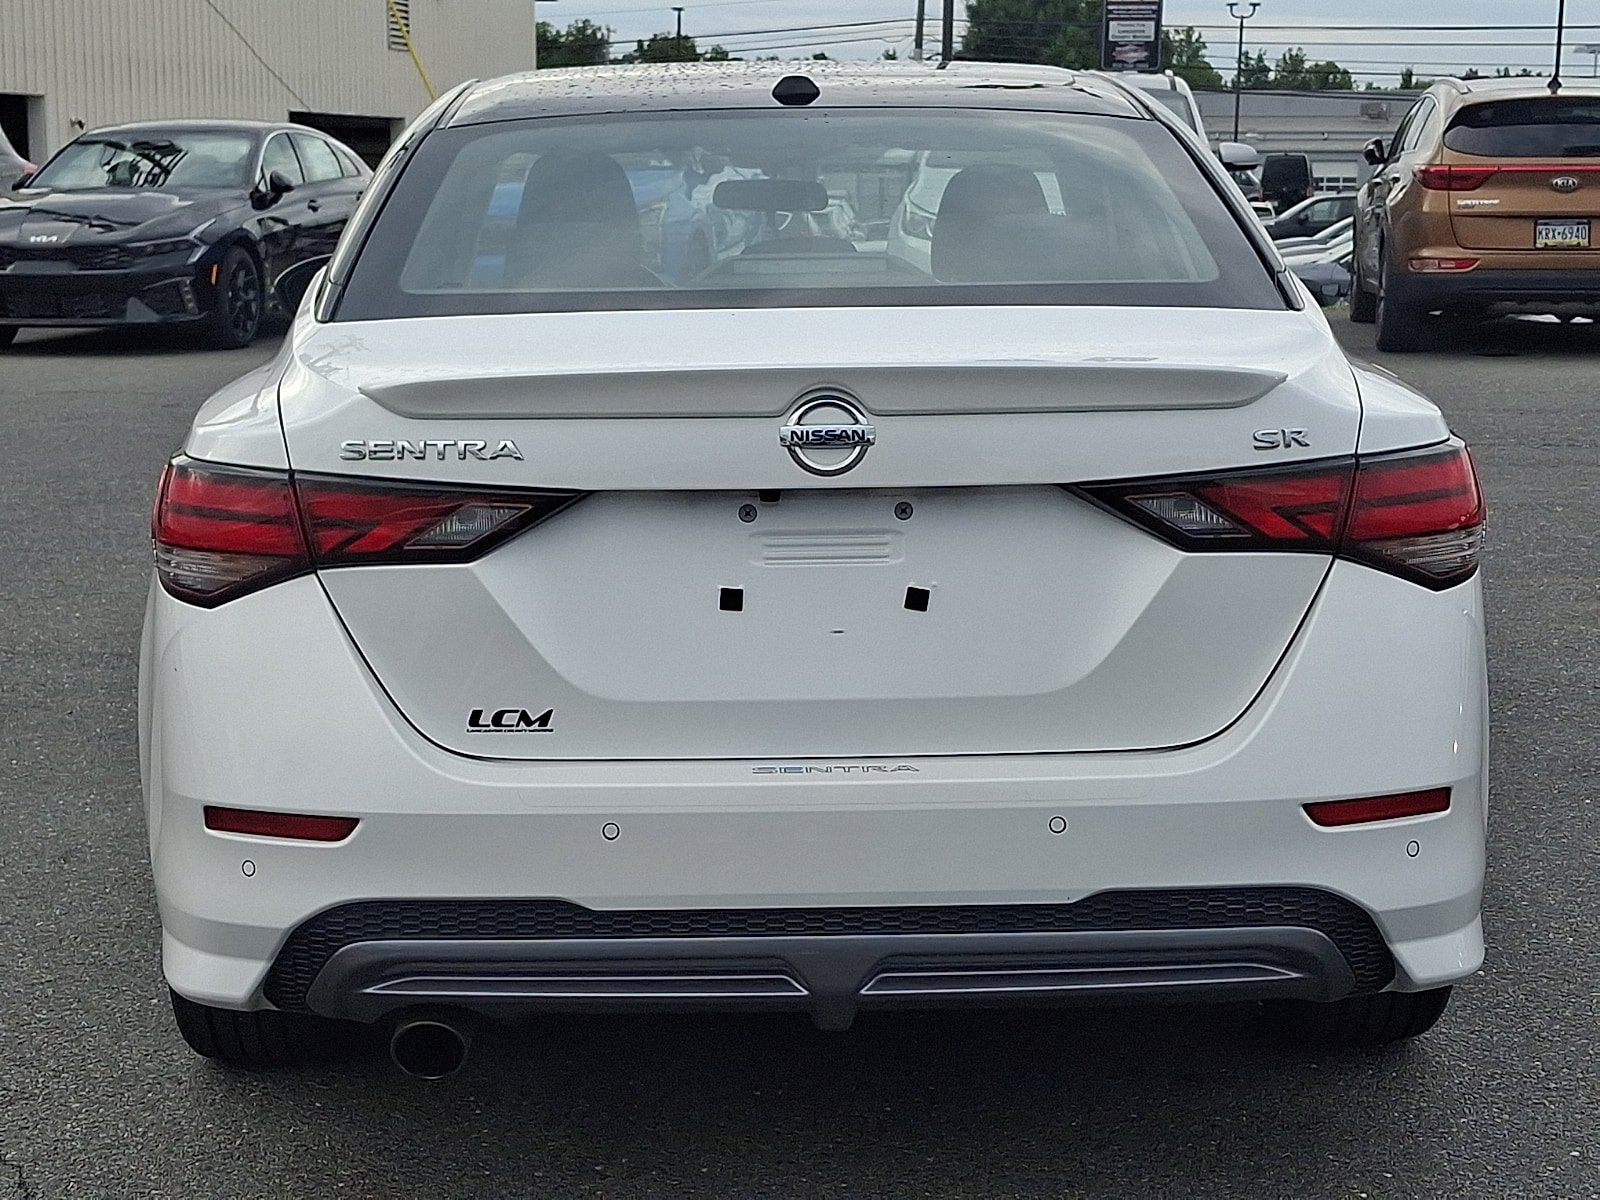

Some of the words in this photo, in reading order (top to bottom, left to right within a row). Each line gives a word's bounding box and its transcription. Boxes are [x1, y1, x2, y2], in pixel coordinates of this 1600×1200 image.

[790, 429, 865, 442] NISSAN
[1253, 428, 1310, 450] SR
[340, 440, 524, 461] SENTRA
[468, 708, 554, 728] LCM
[752, 765, 920, 775] SENTRA
